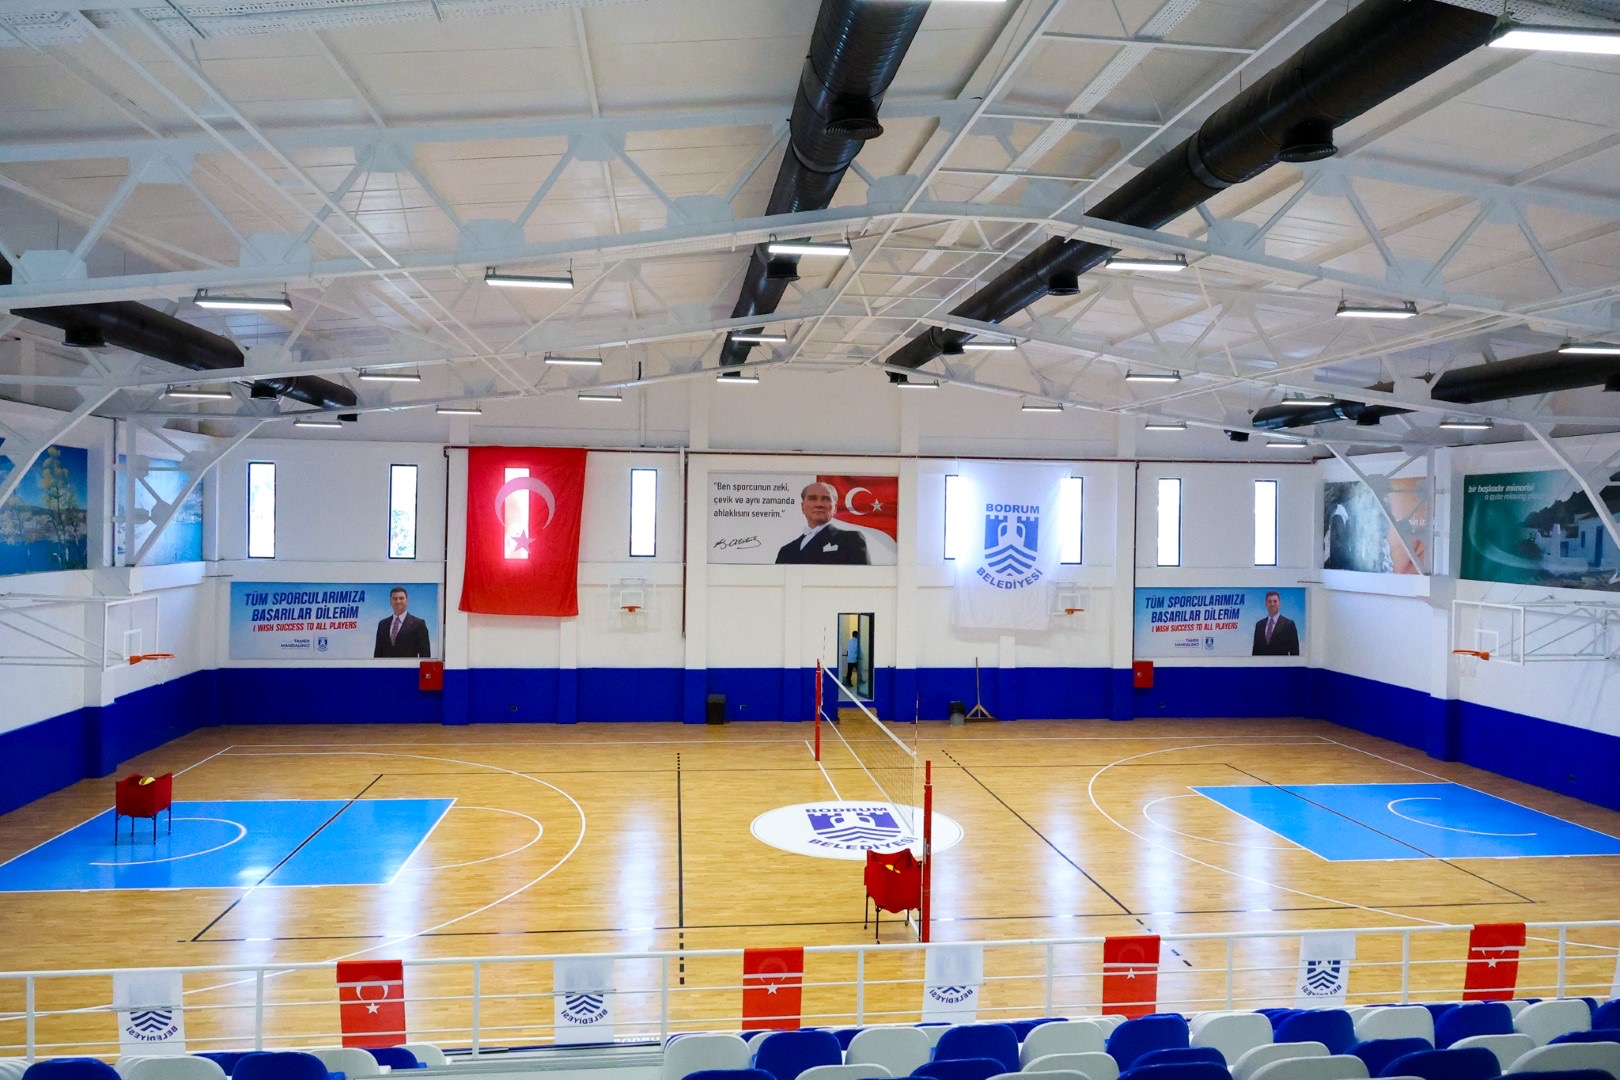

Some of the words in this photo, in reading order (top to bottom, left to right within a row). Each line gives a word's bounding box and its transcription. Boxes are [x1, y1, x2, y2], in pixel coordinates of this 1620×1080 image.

[732, 484, 772, 492] sporcunun
[772, 483, 790, 492] zeki,
[713, 495, 733, 505] çevik
[745, 498, 760, 506] aynı
[761, 497, 795, 505] zamanda
[713, 509, 750, 517] ahlaklısını
[986, 503, 1040, 515] BODRUM
[976, 567, 1044, 590] BELEDİYESİ
[245, 590, 268, 607] TÜM
[272, 590, 366, 605] SPORCULARIMIZA
[1145, 594, 1165, 609] TÜM
[1167, 594, 1245, 608] SPORCULARIMIZA
[251, 607, 313, 622] BAŞARILAR
[315, 604, 360, 620] DİLERİM
[1151, 609, 1201, 623] BAŞARILAR
[1203, 607, 1240, 620] DİLERİM
[252, 624, 256, 632] I
[257, 623, 274, 632] WISH
[275, 623, 304, 632] SUCCESS
[306, 622, 315, 631] TO
[315, 622, 327, 630] ALL
[329, 621, 357, 630] PLAYERS
[1155, 624, 1169, 632] WISH
[1170, 624, 1194, 632] SUCCESS
[1196, 623, 1203, 631] TO
[1215, 622, 1238, 630] PLAYERS
[808, 835, 919, 850] BELEDİYESİ
